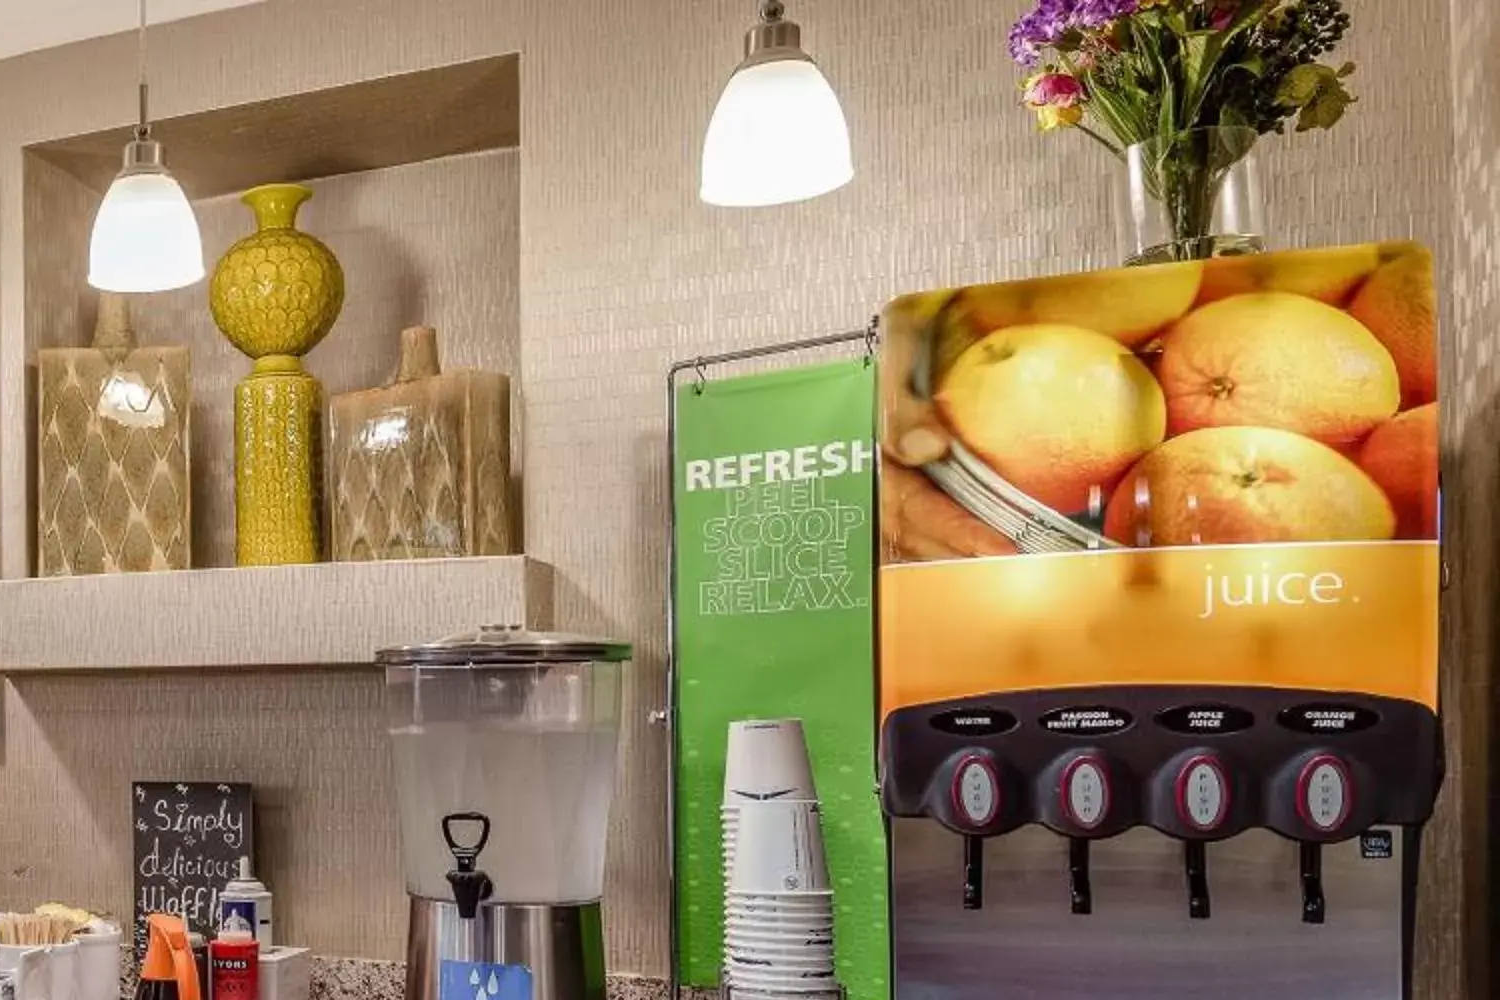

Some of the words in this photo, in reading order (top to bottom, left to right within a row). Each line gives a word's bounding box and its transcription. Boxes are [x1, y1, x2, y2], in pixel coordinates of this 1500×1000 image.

[686, 440, 874, 491] REFRESH
[726, 475, 839, 519] PEEL
[703, 502, 865, 553] SCOOP
[717, 541, 848, 581] SLICE
[699, 572, 868, 616] RELAX.
[1198, 562, 1361, 619] juice.
[954, 715, 992, 726] WATER
[1187, 711, 1224, 720] APPLE
[1189, 719, 1222, 729] JUICE
[1305, 711, 1355, 721] ORANGE
[1311, 719, 1346, 729] JUICE
[154, 799, 243, 848] Simply
[140, 837, 241, 880] delicious
